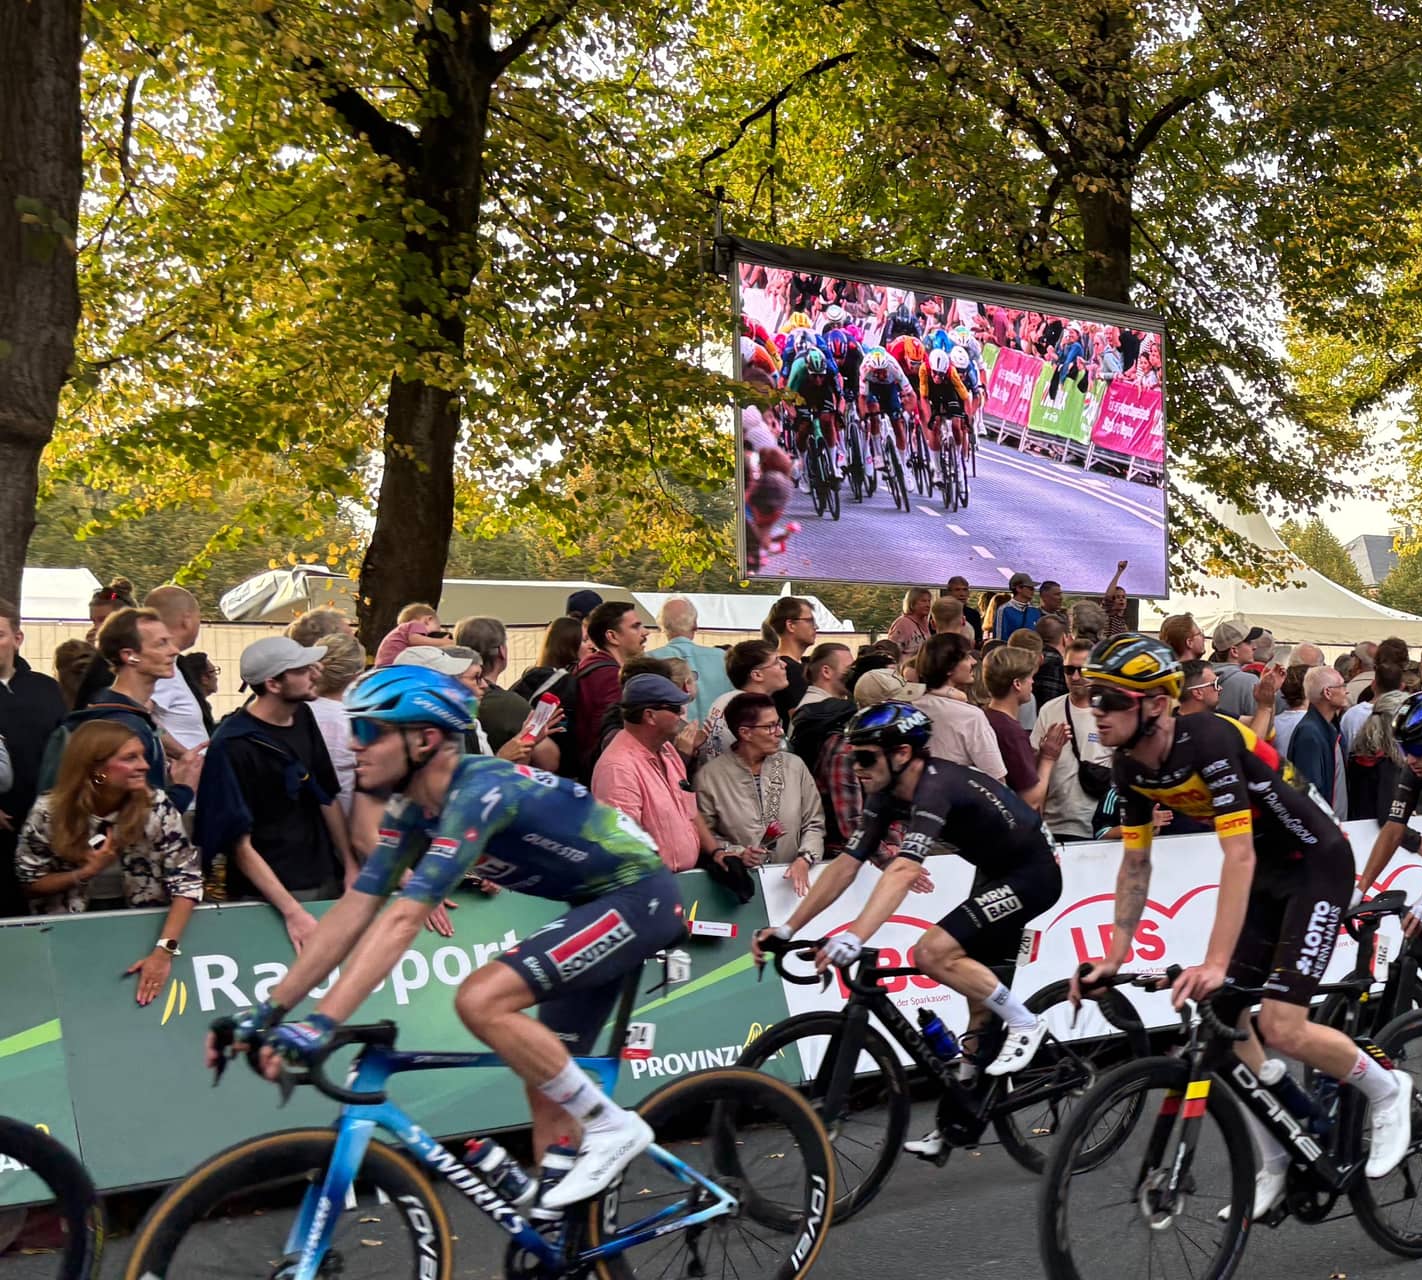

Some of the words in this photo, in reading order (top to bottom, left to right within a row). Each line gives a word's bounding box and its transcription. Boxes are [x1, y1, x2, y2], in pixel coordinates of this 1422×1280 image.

[521, 833, 590, 863] QUICK-STEP
[974, 884, 1014, 907] MRW
[985, 898, 1020, 920] BAU
[1303, 900, 1331, 957] LOTTO
[191, 929, 519, 1012] Raport
[560, 925, 632, 978] SOUDAL
[911, 993, 951, 1007] Sparkassen
[631, 1041, 777, 1079] PROVINZI
[1231, 1062, 1323, 1162] DARE
[402, 1124, 523, 1235] S-WORKS
